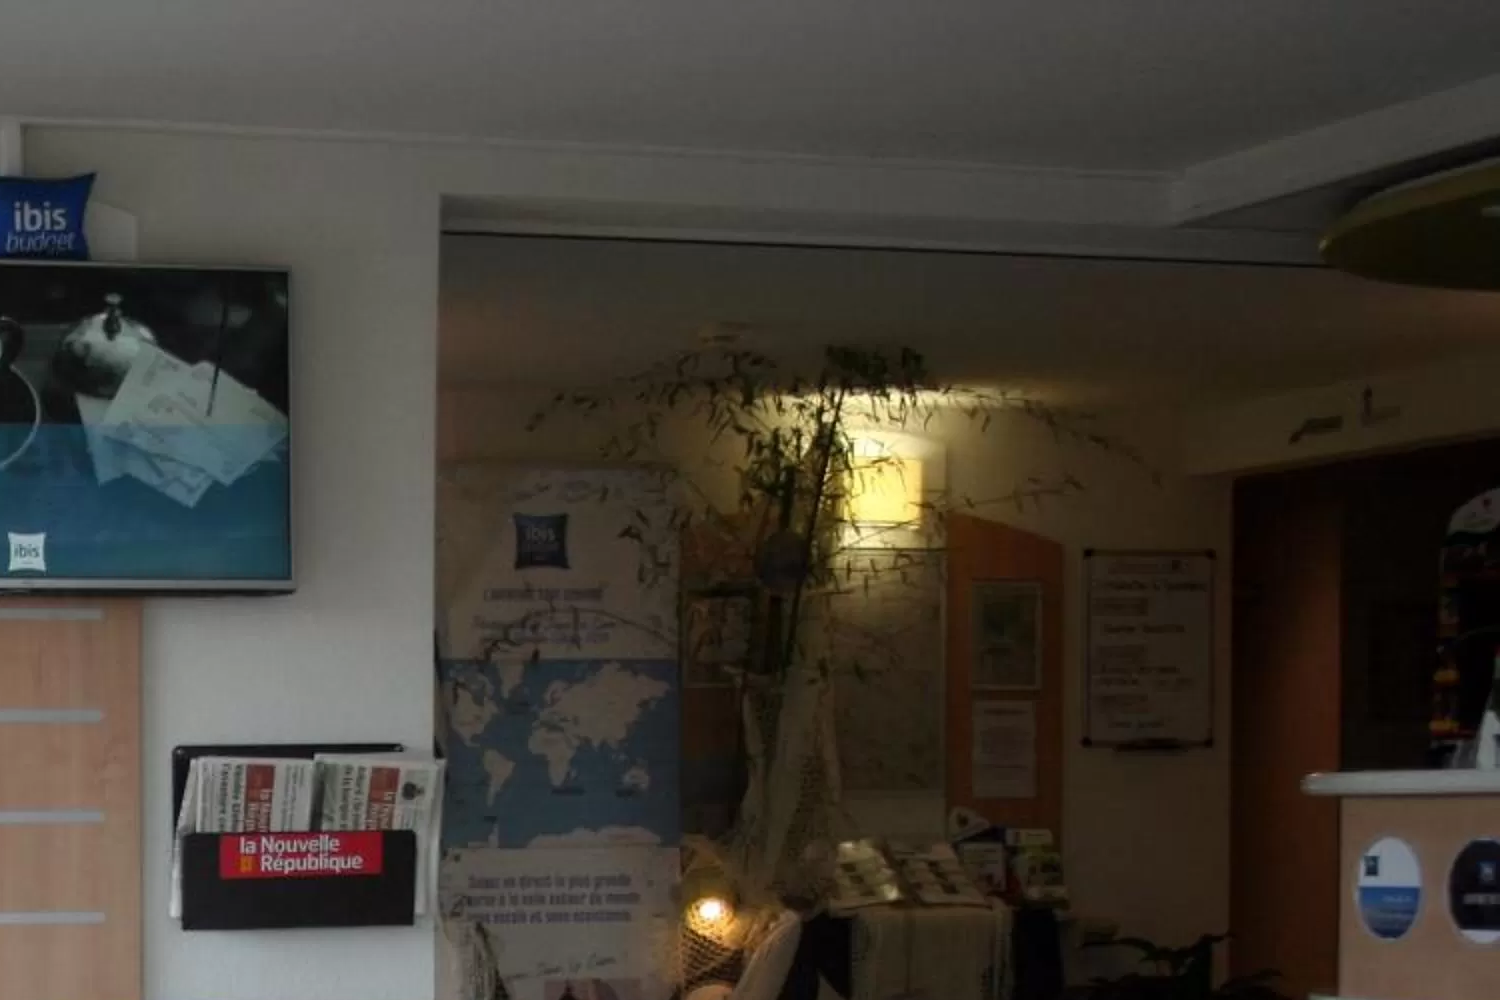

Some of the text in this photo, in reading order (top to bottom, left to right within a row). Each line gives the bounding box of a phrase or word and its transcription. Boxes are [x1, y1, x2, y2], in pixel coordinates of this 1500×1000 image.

[14, 201, 67, 232] ibis
[14, 543, 40, 558] ibis
[240, 835, 340, 854] la Nouvelle
[261, 852, 363, 874] République
